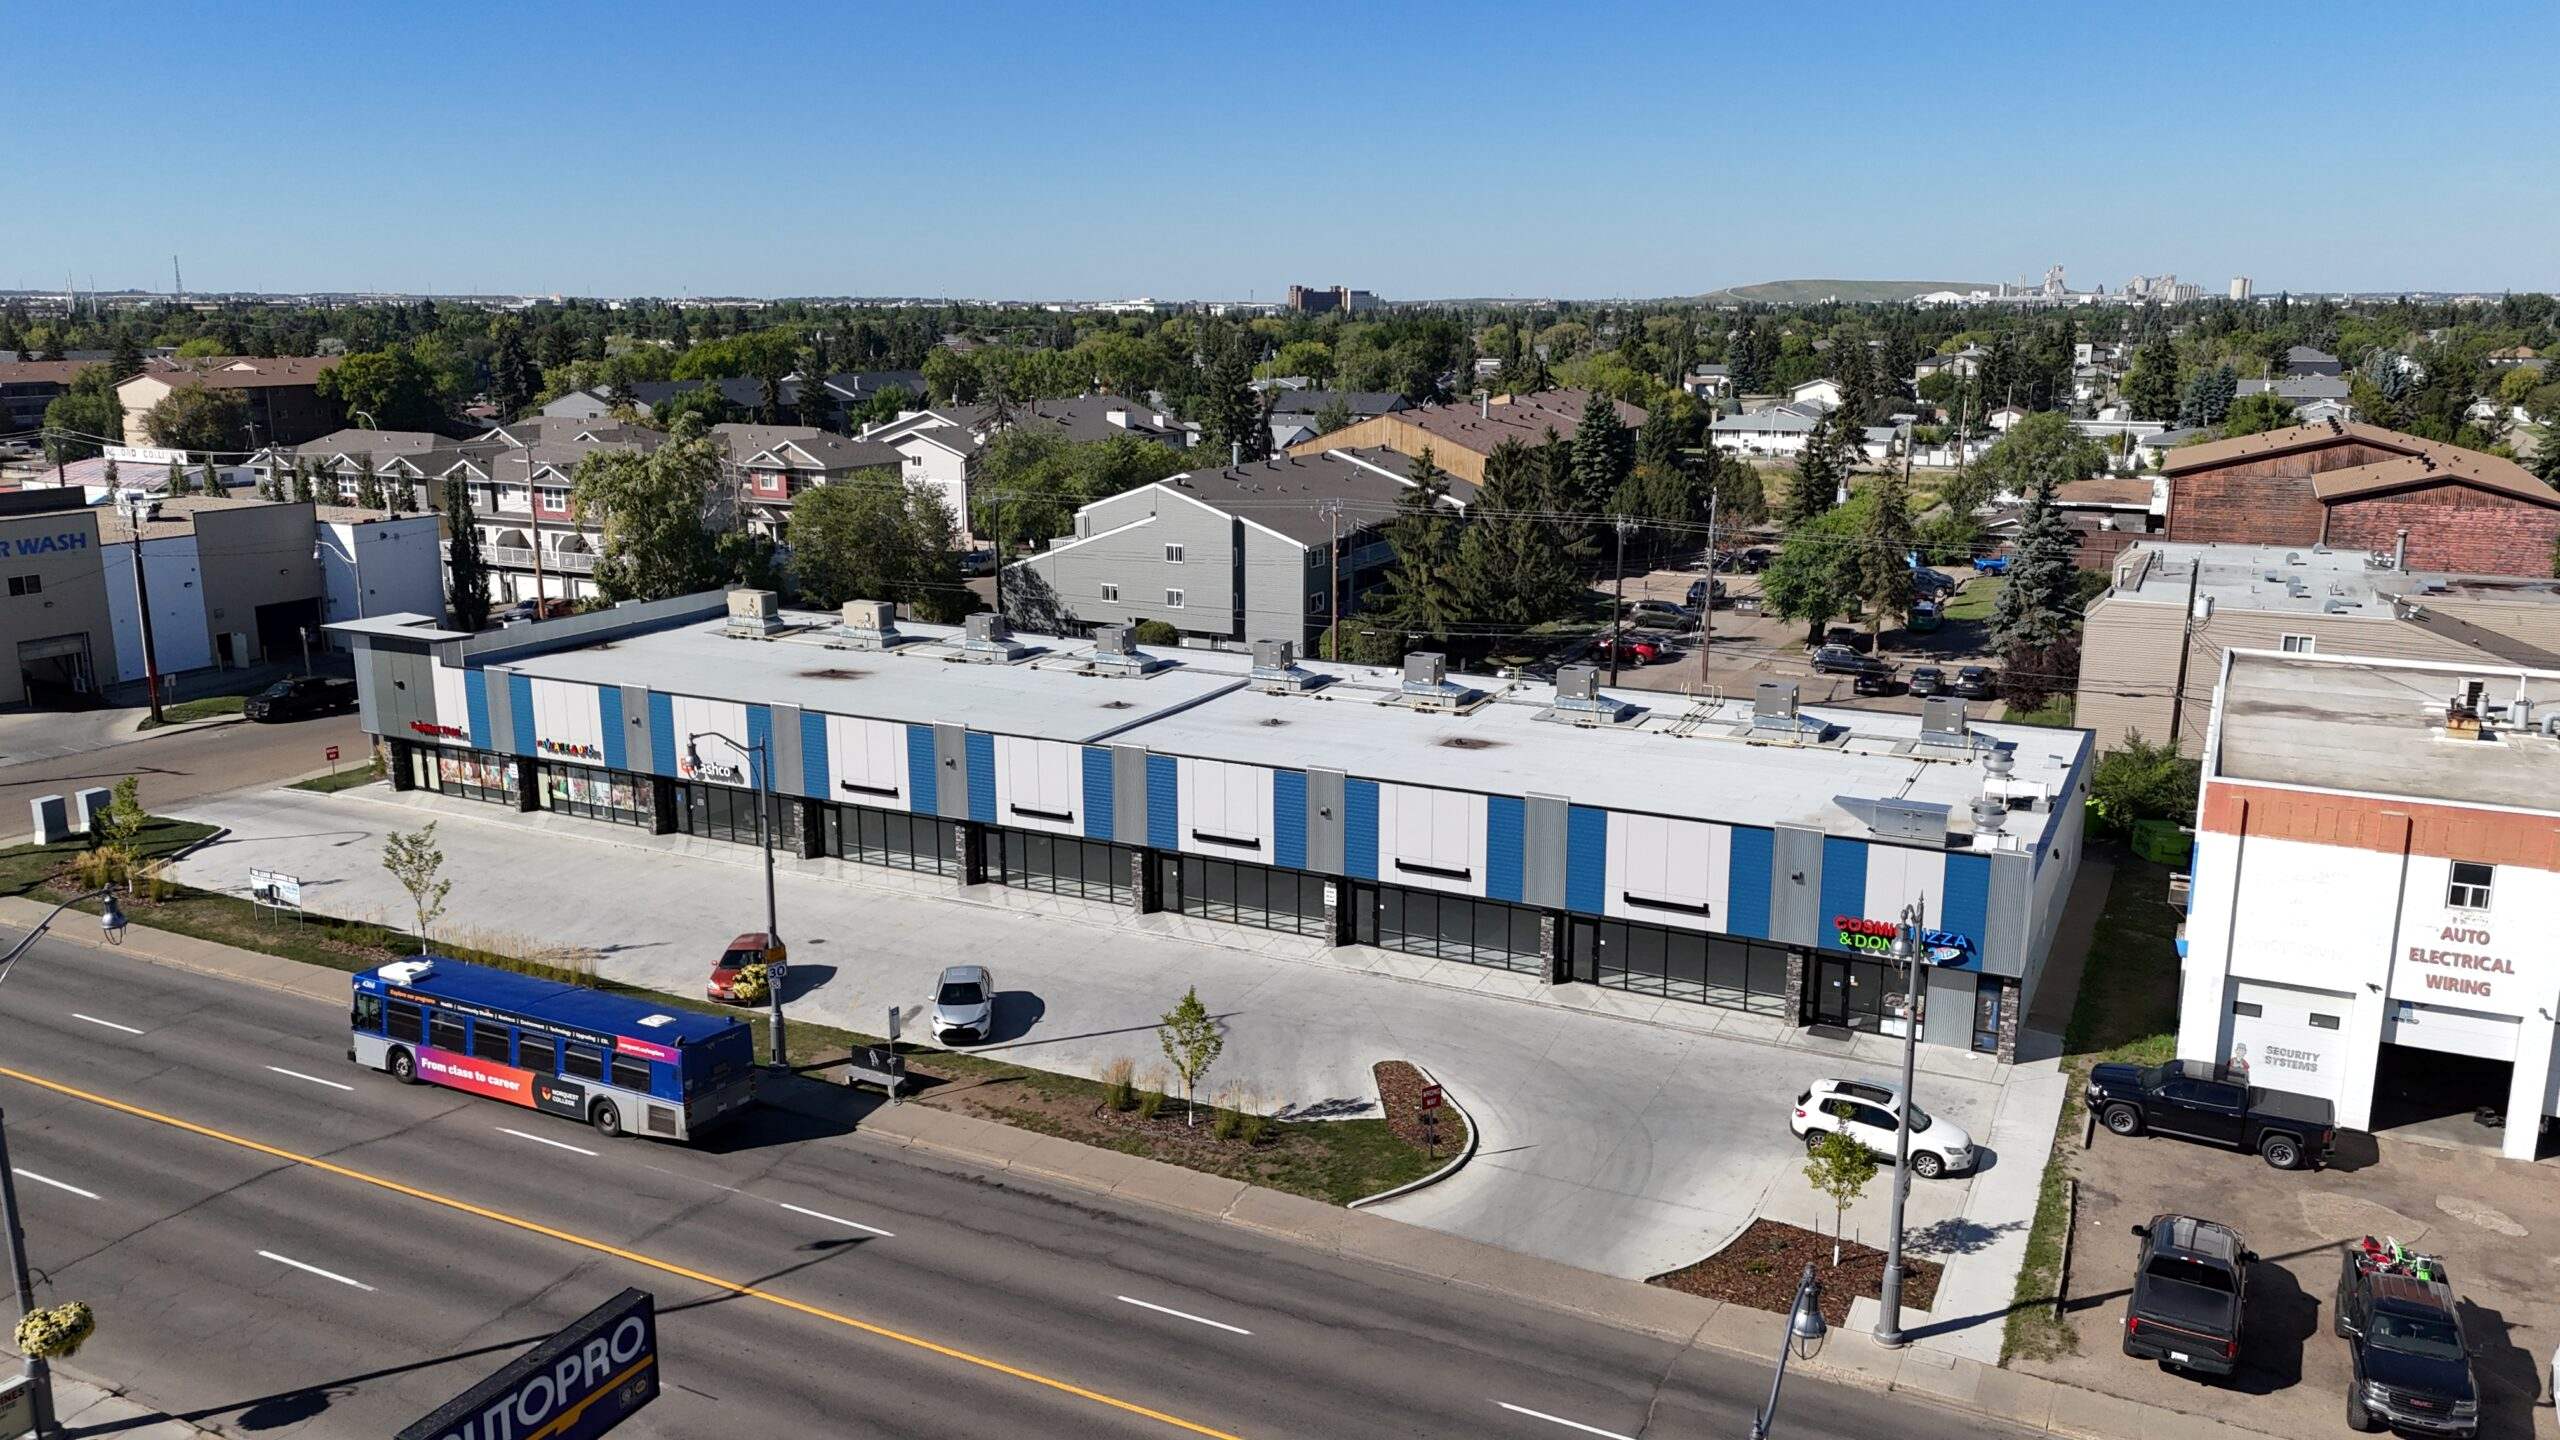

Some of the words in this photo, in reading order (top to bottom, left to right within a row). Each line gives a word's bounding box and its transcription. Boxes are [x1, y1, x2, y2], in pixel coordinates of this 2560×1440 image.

[16, 532, 86, 555] WASH
[1839, 931, 1852, 946] &
[2440, 926, 2491, 945] AUTO
[2409, 947, 2515, 975] ELECTRICAL
[769, 965, 786, 978] 30
[2425, 974, 2491, 997] WIRING
[2265, 1045, 2320, 1061] SECURITY
[2264, 1055, 2318, 1072] SYSTEMS
[421, 1057, 447, 1074] From
[448, 1064, 474, 1079] class
[475, 1071, 486, 1083] to
[488, 1076, 520, 1091] career
[552, 1096, 575, 1107] COLLEGE
[440, 1316, 646, 1440] TOPRO
